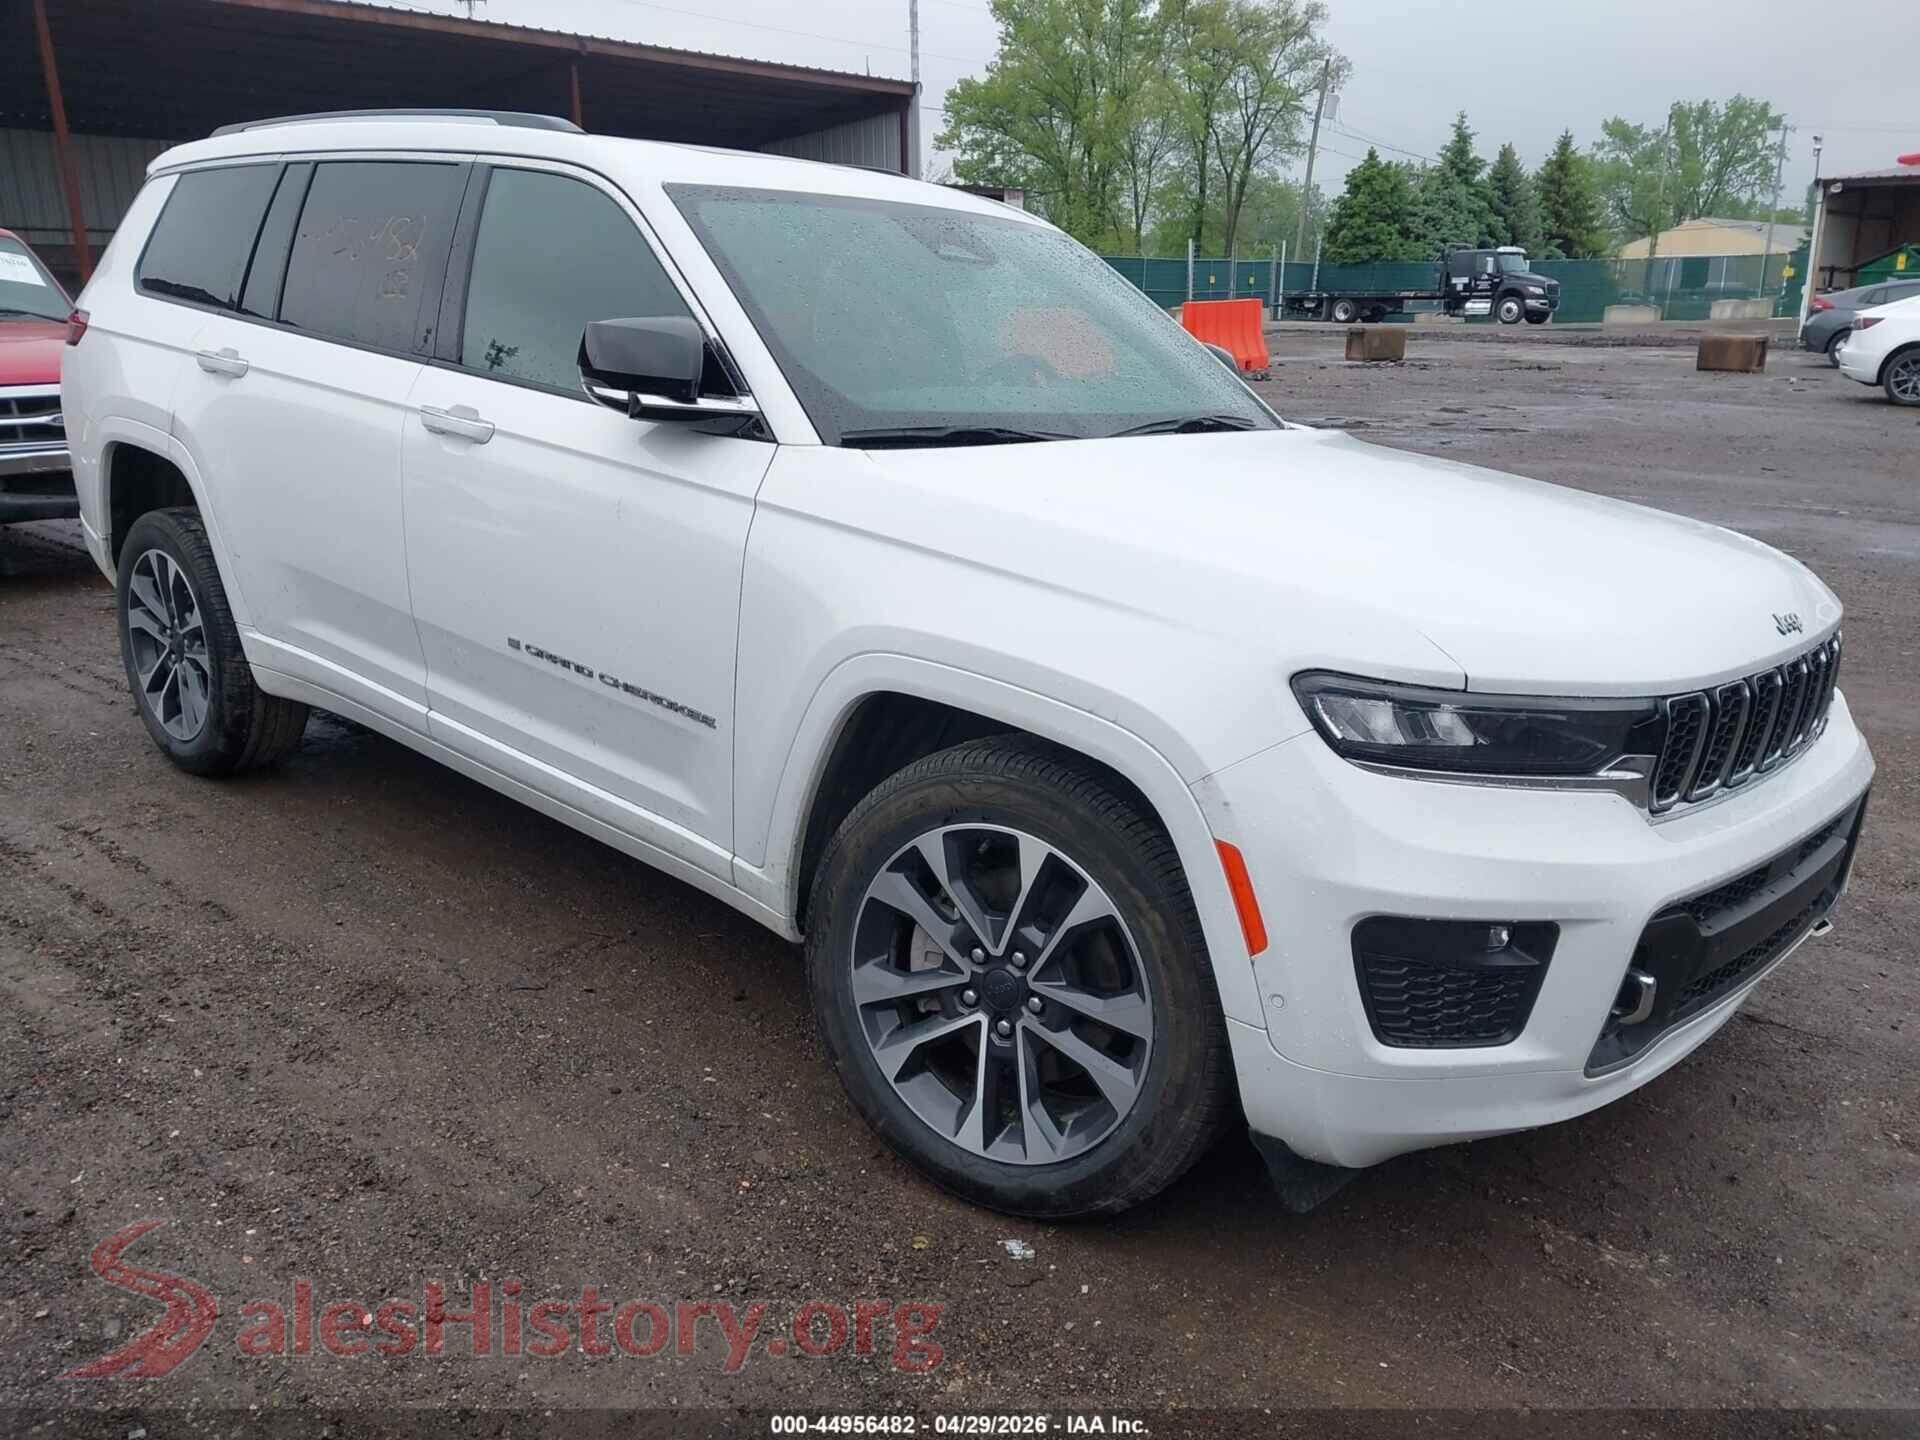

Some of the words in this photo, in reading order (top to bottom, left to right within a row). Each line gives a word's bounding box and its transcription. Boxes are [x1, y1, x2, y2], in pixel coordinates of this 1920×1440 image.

[1771, 612, 1803, 636] Jeep
[524, 643, 594, 679] GRAND
[598, 671, 717, 730] CHEROKEE
